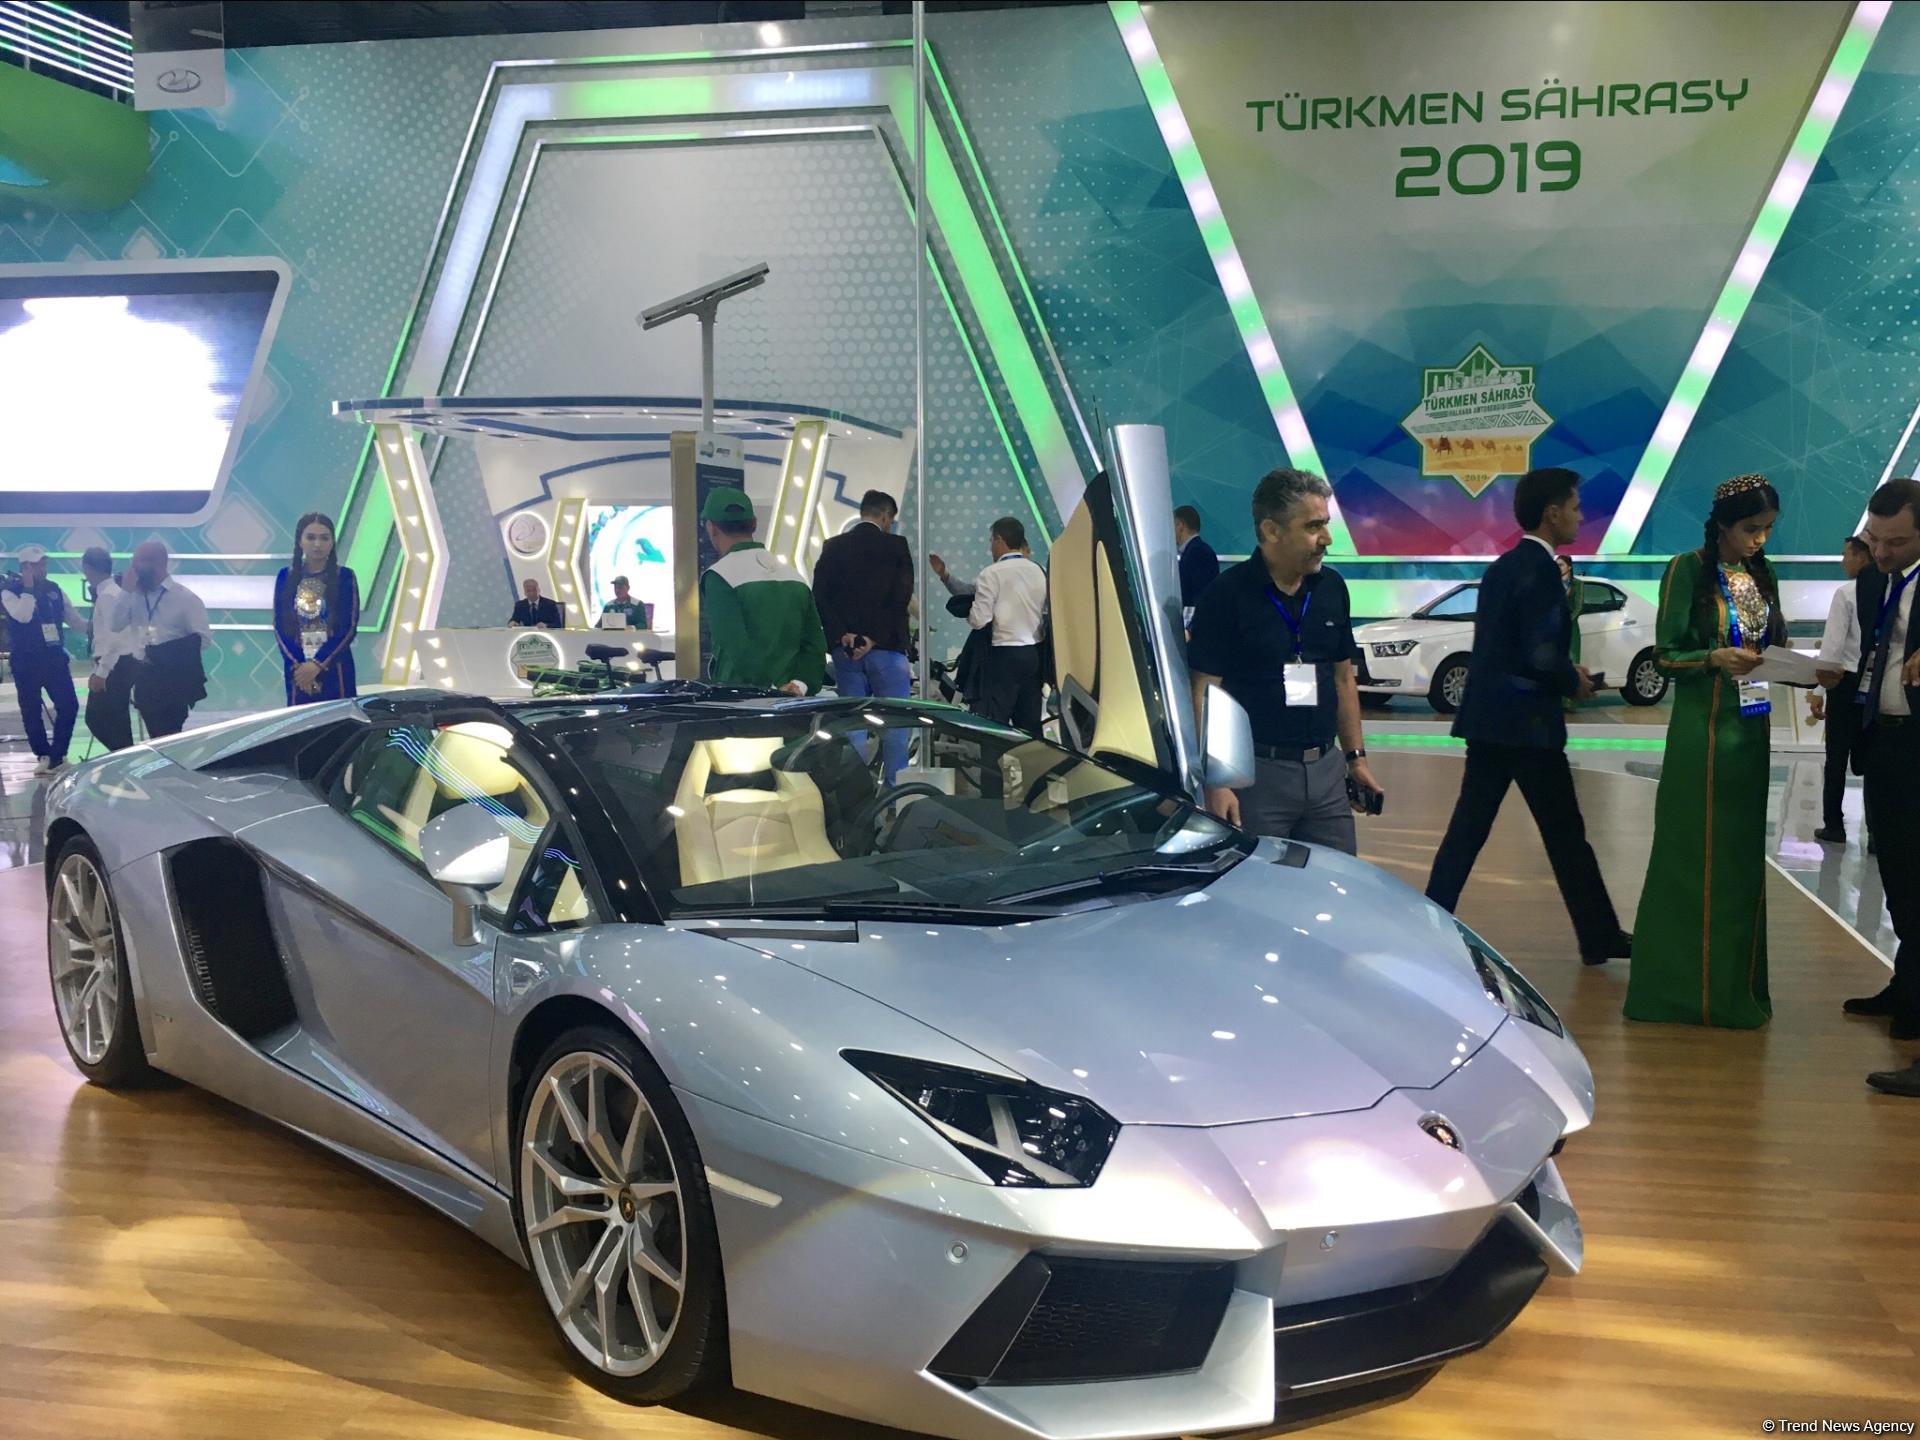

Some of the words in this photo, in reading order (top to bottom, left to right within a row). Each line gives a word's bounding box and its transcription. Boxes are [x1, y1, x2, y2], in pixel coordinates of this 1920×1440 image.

[1246, 91, 1483, 132] TÜRKMEN
[1501, 78, 1748, 121] SÄHRASY
[1395, 141, 1581, 197] 2019
[1424, 393, 1477, 411] TÜRKMEN
[1481, 386, 1533, 404] SÄHRASY
